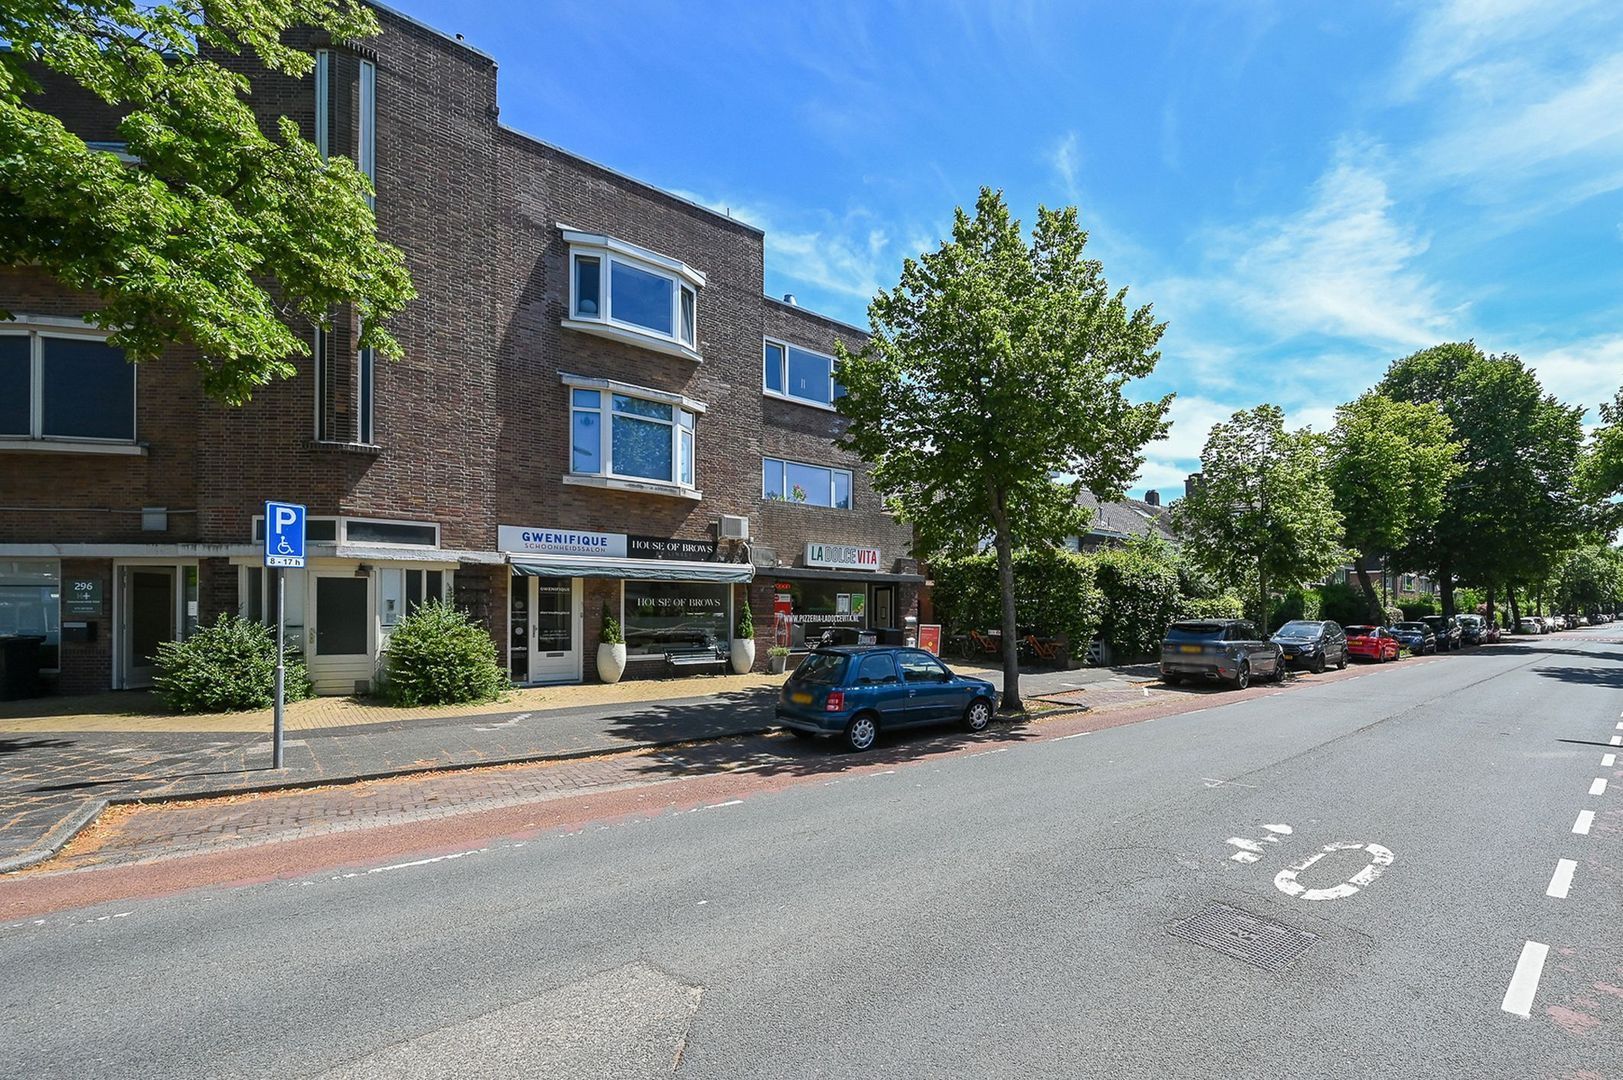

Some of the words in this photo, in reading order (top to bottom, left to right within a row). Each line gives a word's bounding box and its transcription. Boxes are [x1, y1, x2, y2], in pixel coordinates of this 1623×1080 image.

[276, 507, 297, 535] P
[522, 532, 608, 547] GWENIFIQUE
[524, 543, 606, 553] SCHOONHEIDSSALON
[632, 540, 664, 551] HOUSE
[666, 543, 680, 551] OF
[682, 544, 713, 553] BROWS
[811, 546, 823, 561] LA
[824, 547, 857, 564] DOLCE
[857, 549, 877, 565] VITA
[74, 582, 93, 591] 296
[637, 597, 671, 607] HOUSE
[673, 598, 687, 607] OF
[689, 598, 721, 607] BROWS
